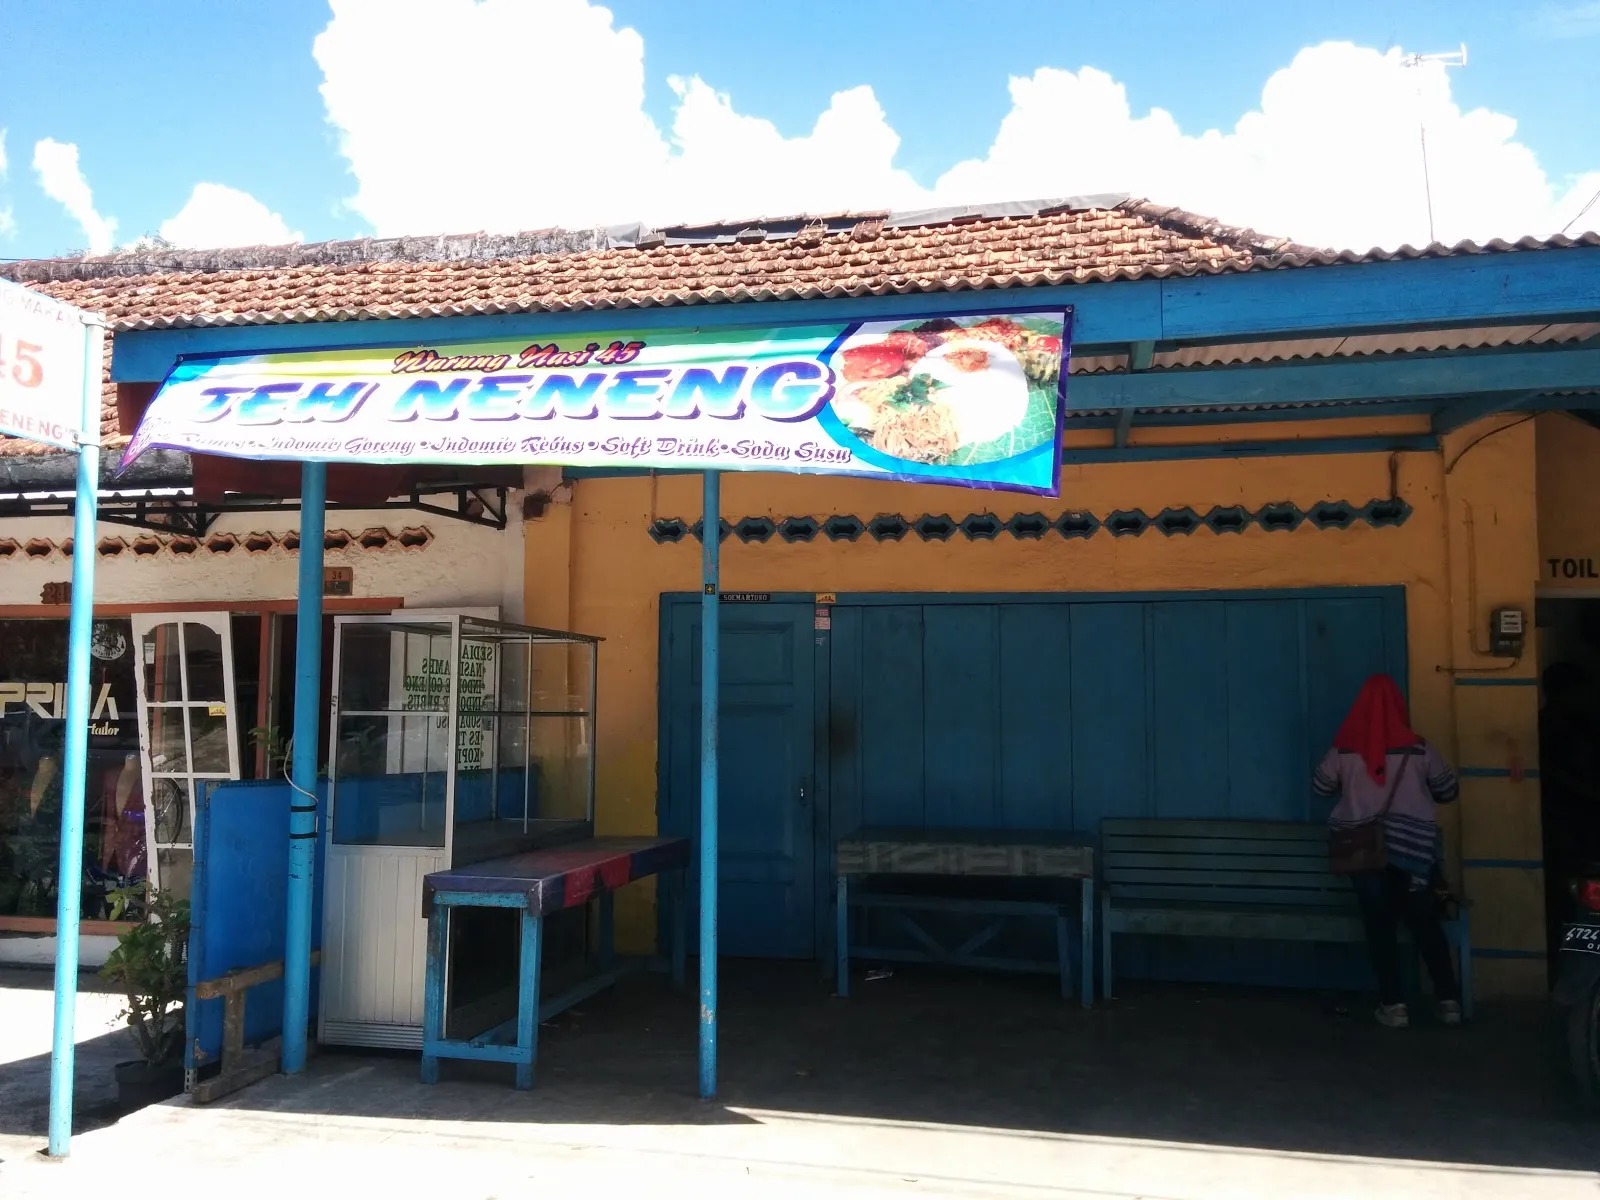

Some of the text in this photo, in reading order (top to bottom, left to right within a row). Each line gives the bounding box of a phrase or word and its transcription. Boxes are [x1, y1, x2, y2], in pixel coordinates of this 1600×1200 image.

[391, 341, 647, 373] Warung Nasi 45
[191, 361, 836, 426] TEH NENENG
[344, 436, 416, 455] Goreng
[431, 436, 516, 453] Indomie
[521, 435, 584, 453] Rebus
[600, 436, 651, 457] Soft
[656, 436, 720, 457] Drink
[731, 439, 791, 459] Soda
[794, 441, 852, 463] Susu
[1547, 558, 1599, 579] TOIL
[0, 683, 119, 720] PRIA
